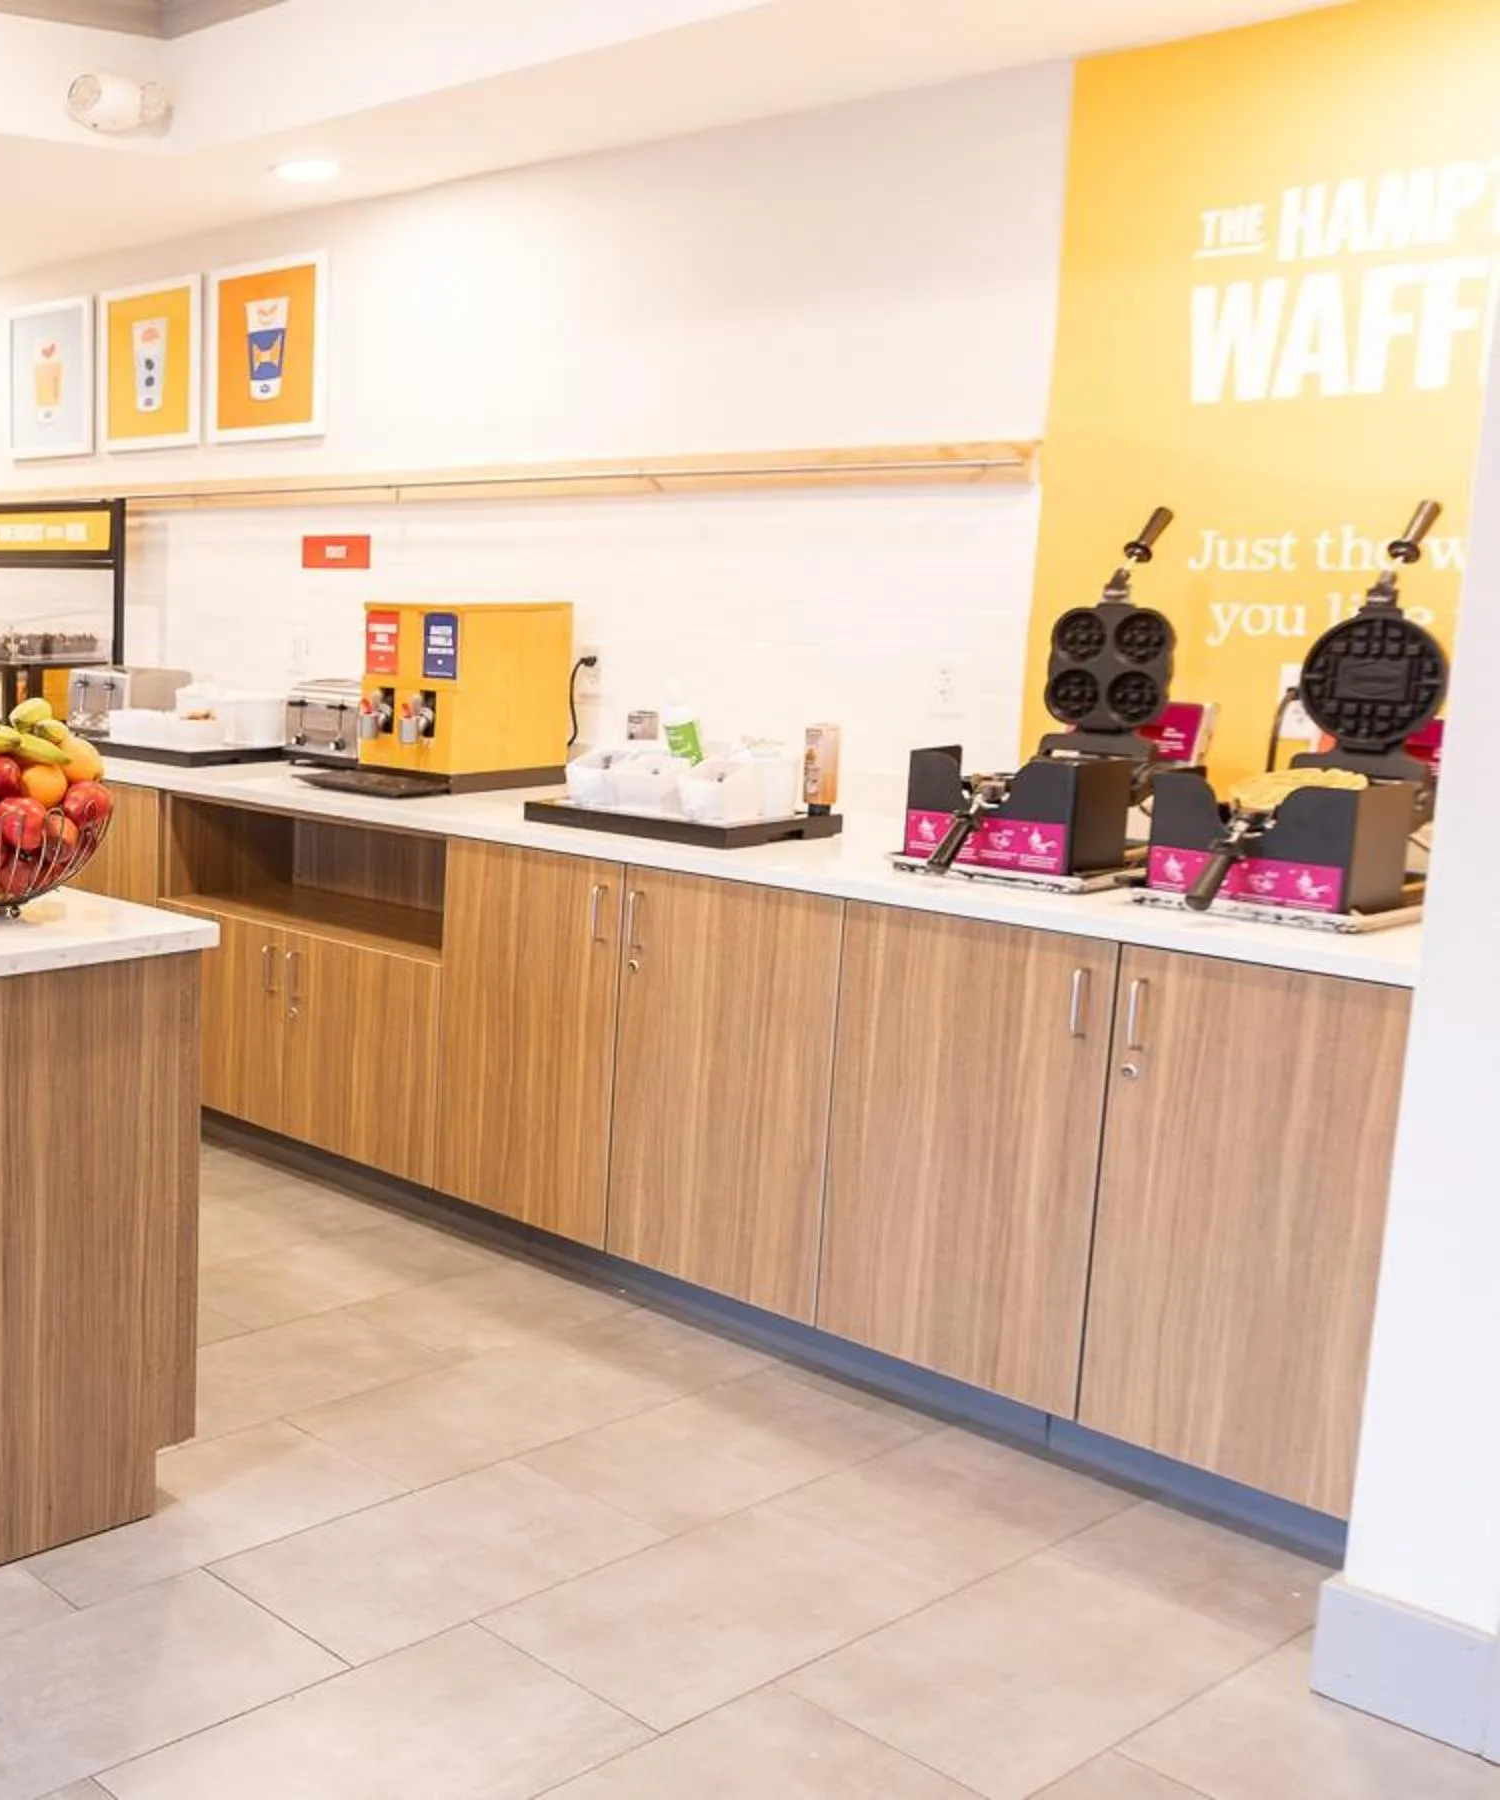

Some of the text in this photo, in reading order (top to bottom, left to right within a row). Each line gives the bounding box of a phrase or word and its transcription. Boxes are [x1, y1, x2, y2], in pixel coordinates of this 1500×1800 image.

[1200, 157, 1500, 262] THE HAMP
[1188, 530, 1297, 571] Just
[1205, 602, 1306, 646] you
